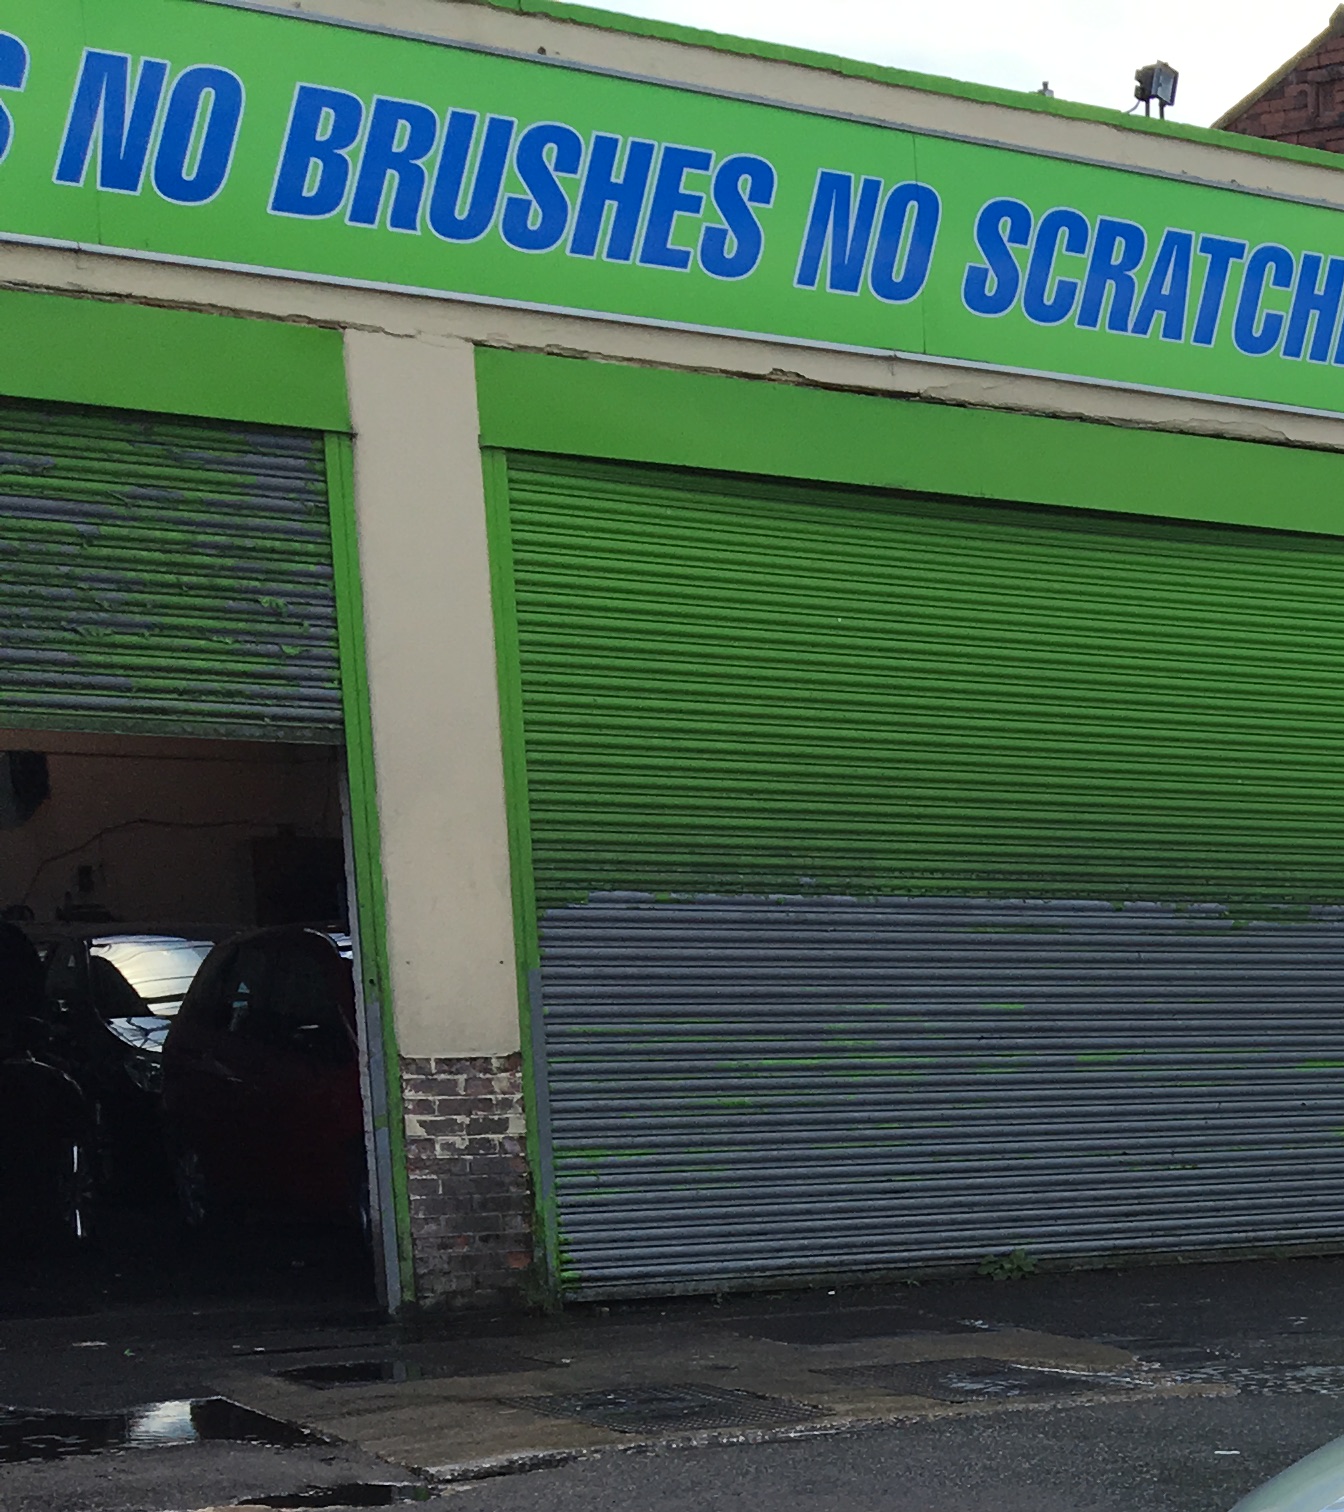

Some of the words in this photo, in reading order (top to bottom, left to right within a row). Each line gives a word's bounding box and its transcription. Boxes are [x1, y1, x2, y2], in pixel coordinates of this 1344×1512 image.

[52, 46, 245, 206] NO
[267, 82, 778, 281] BRUSHES
[794, 167, 942, 305] NO
